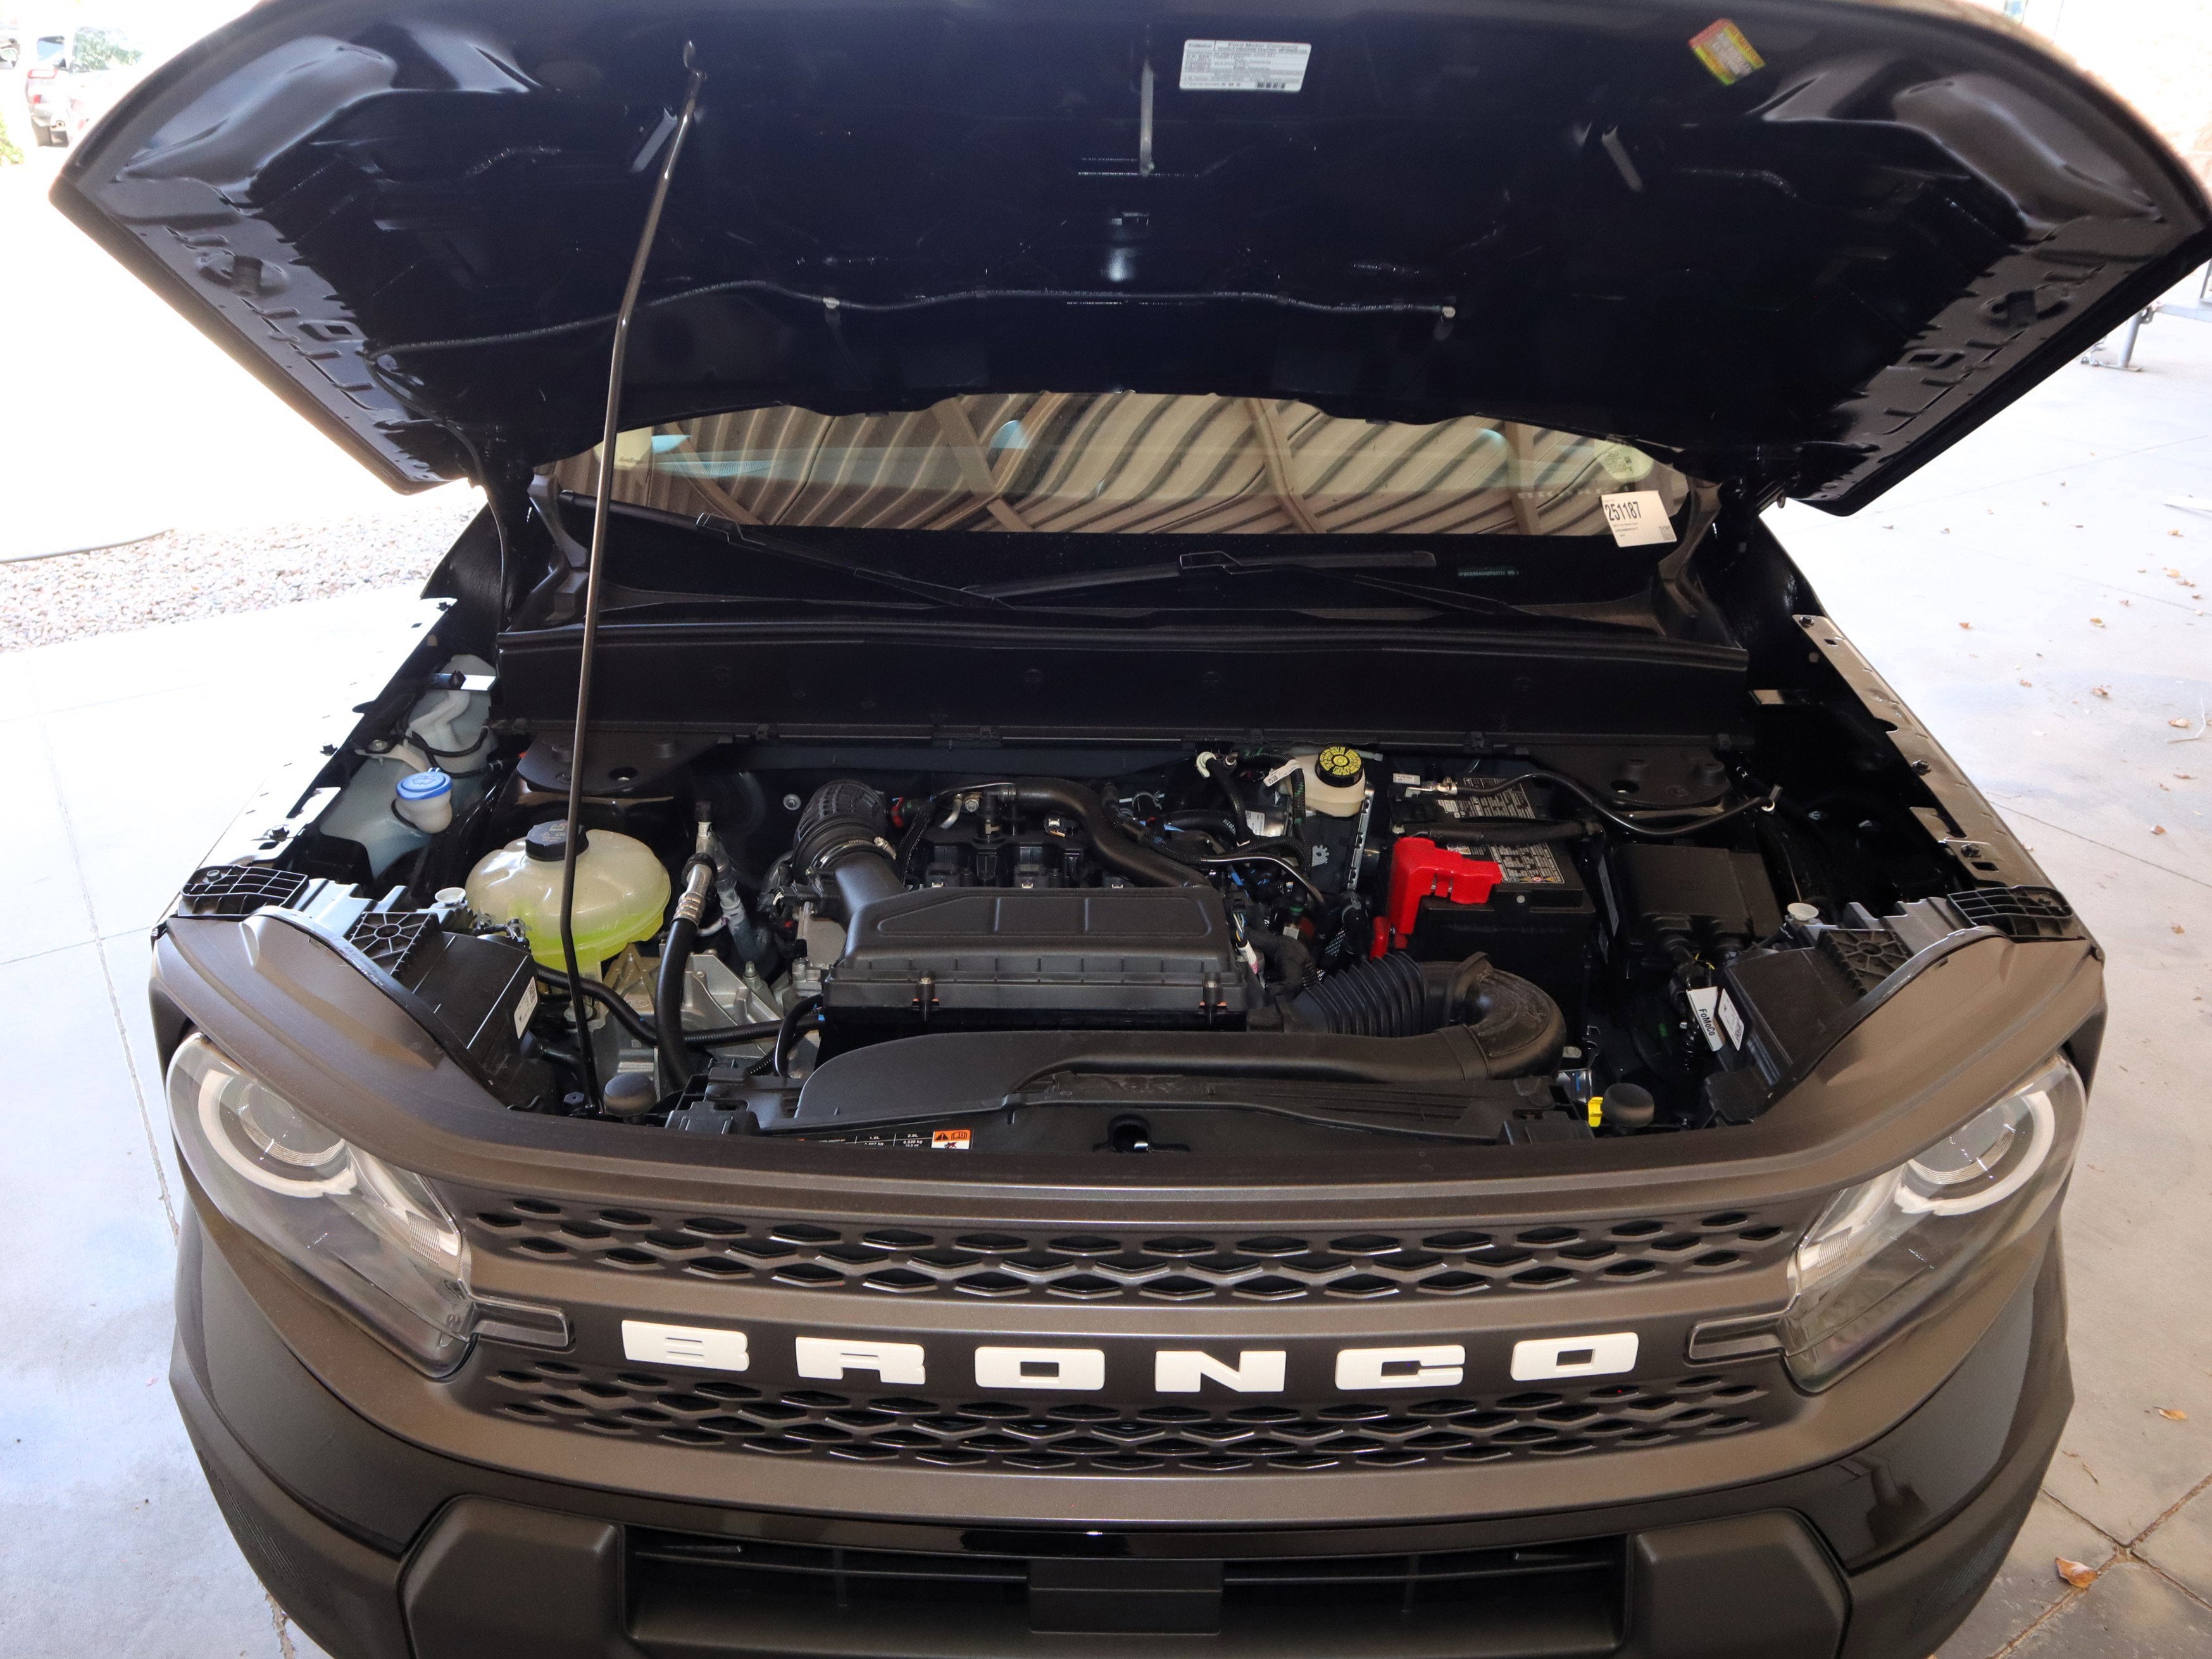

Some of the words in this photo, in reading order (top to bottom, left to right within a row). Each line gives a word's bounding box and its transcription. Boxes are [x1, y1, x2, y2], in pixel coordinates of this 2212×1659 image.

[1604, 501, 1641, 521] 251187
[1699, 1008, 1715, 1036] FoMoCo
[622, 1320, 1639, 1392] BRONCO
